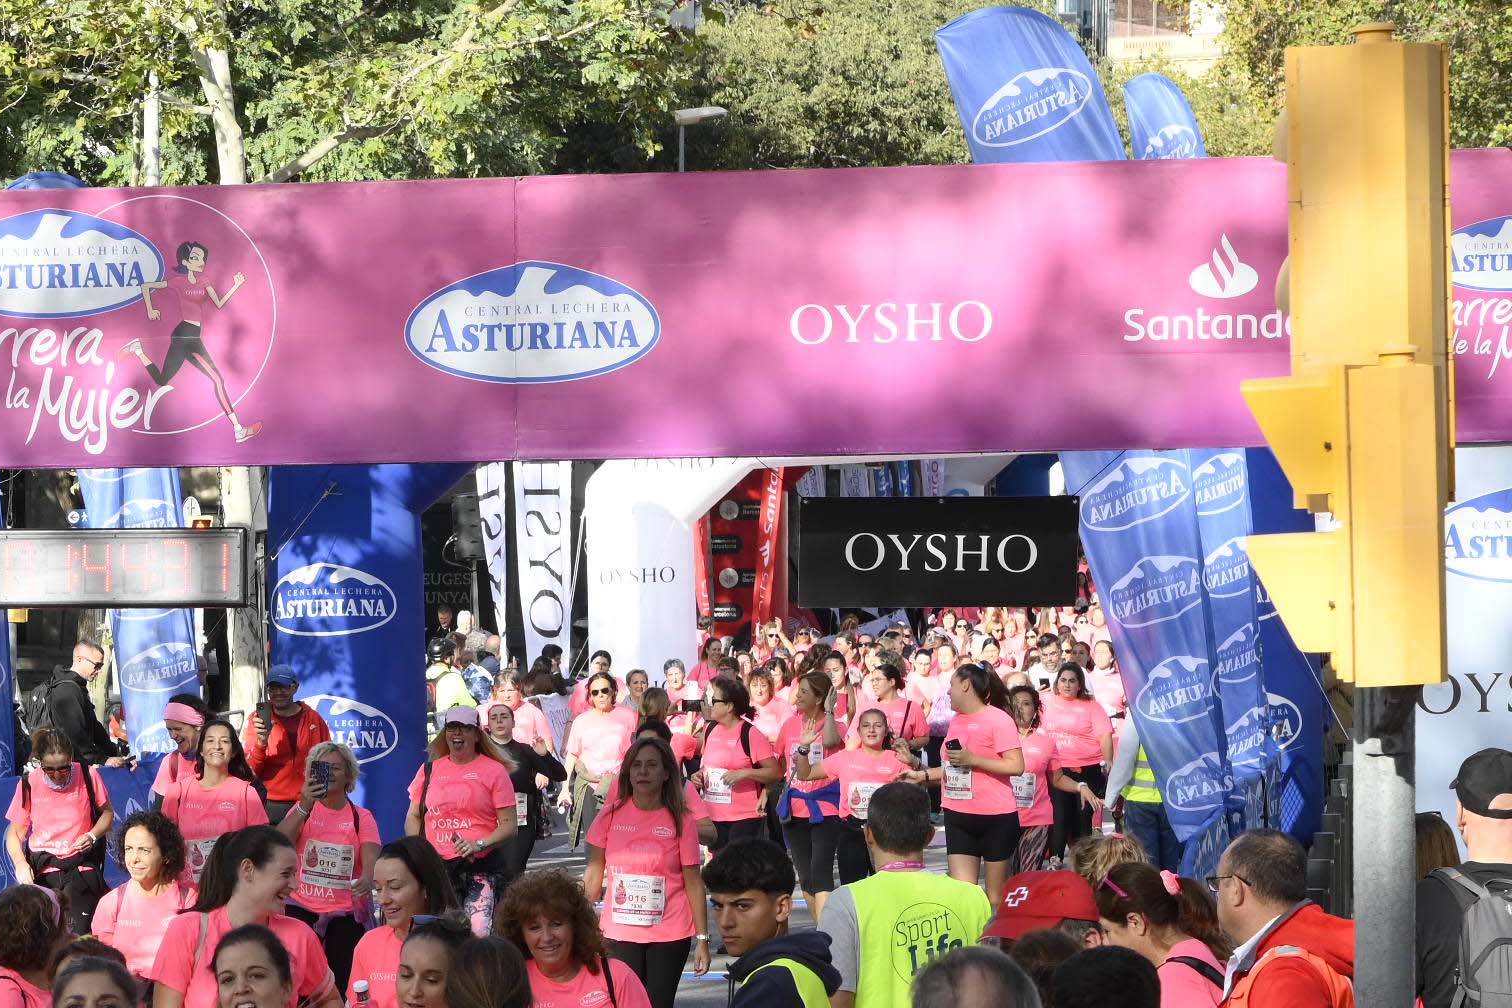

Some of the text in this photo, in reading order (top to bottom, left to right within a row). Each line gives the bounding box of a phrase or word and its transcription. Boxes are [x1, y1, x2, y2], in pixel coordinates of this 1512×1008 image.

[67, 243, 139, 256] LECHERA
[464, 302, 633, 317] CENTRAL LECHERA
[424, 308, 640, 353] ASTURIANA
[790, 299, 993, 345] OYSHO
[1475, 326, 1493, 355] la
[6, 366, 31, 410] la
[26, 362, 175, 455] Mujer
[844, 531, 1038, 574] OYSHO
[600, 566, 675, 584] OYSHO
[287, 588, 383, 597] CENTRAL LECHERA
[275, 592, 388, 620] ASTURIANA
[335, 719, 383, 727] LECHERA
[319, 858, 336, 868] 016
[300, 885, 335, 898] SUMA
[628, 894, 647, 903] 016
[896, 910, 952, 950] Sport
